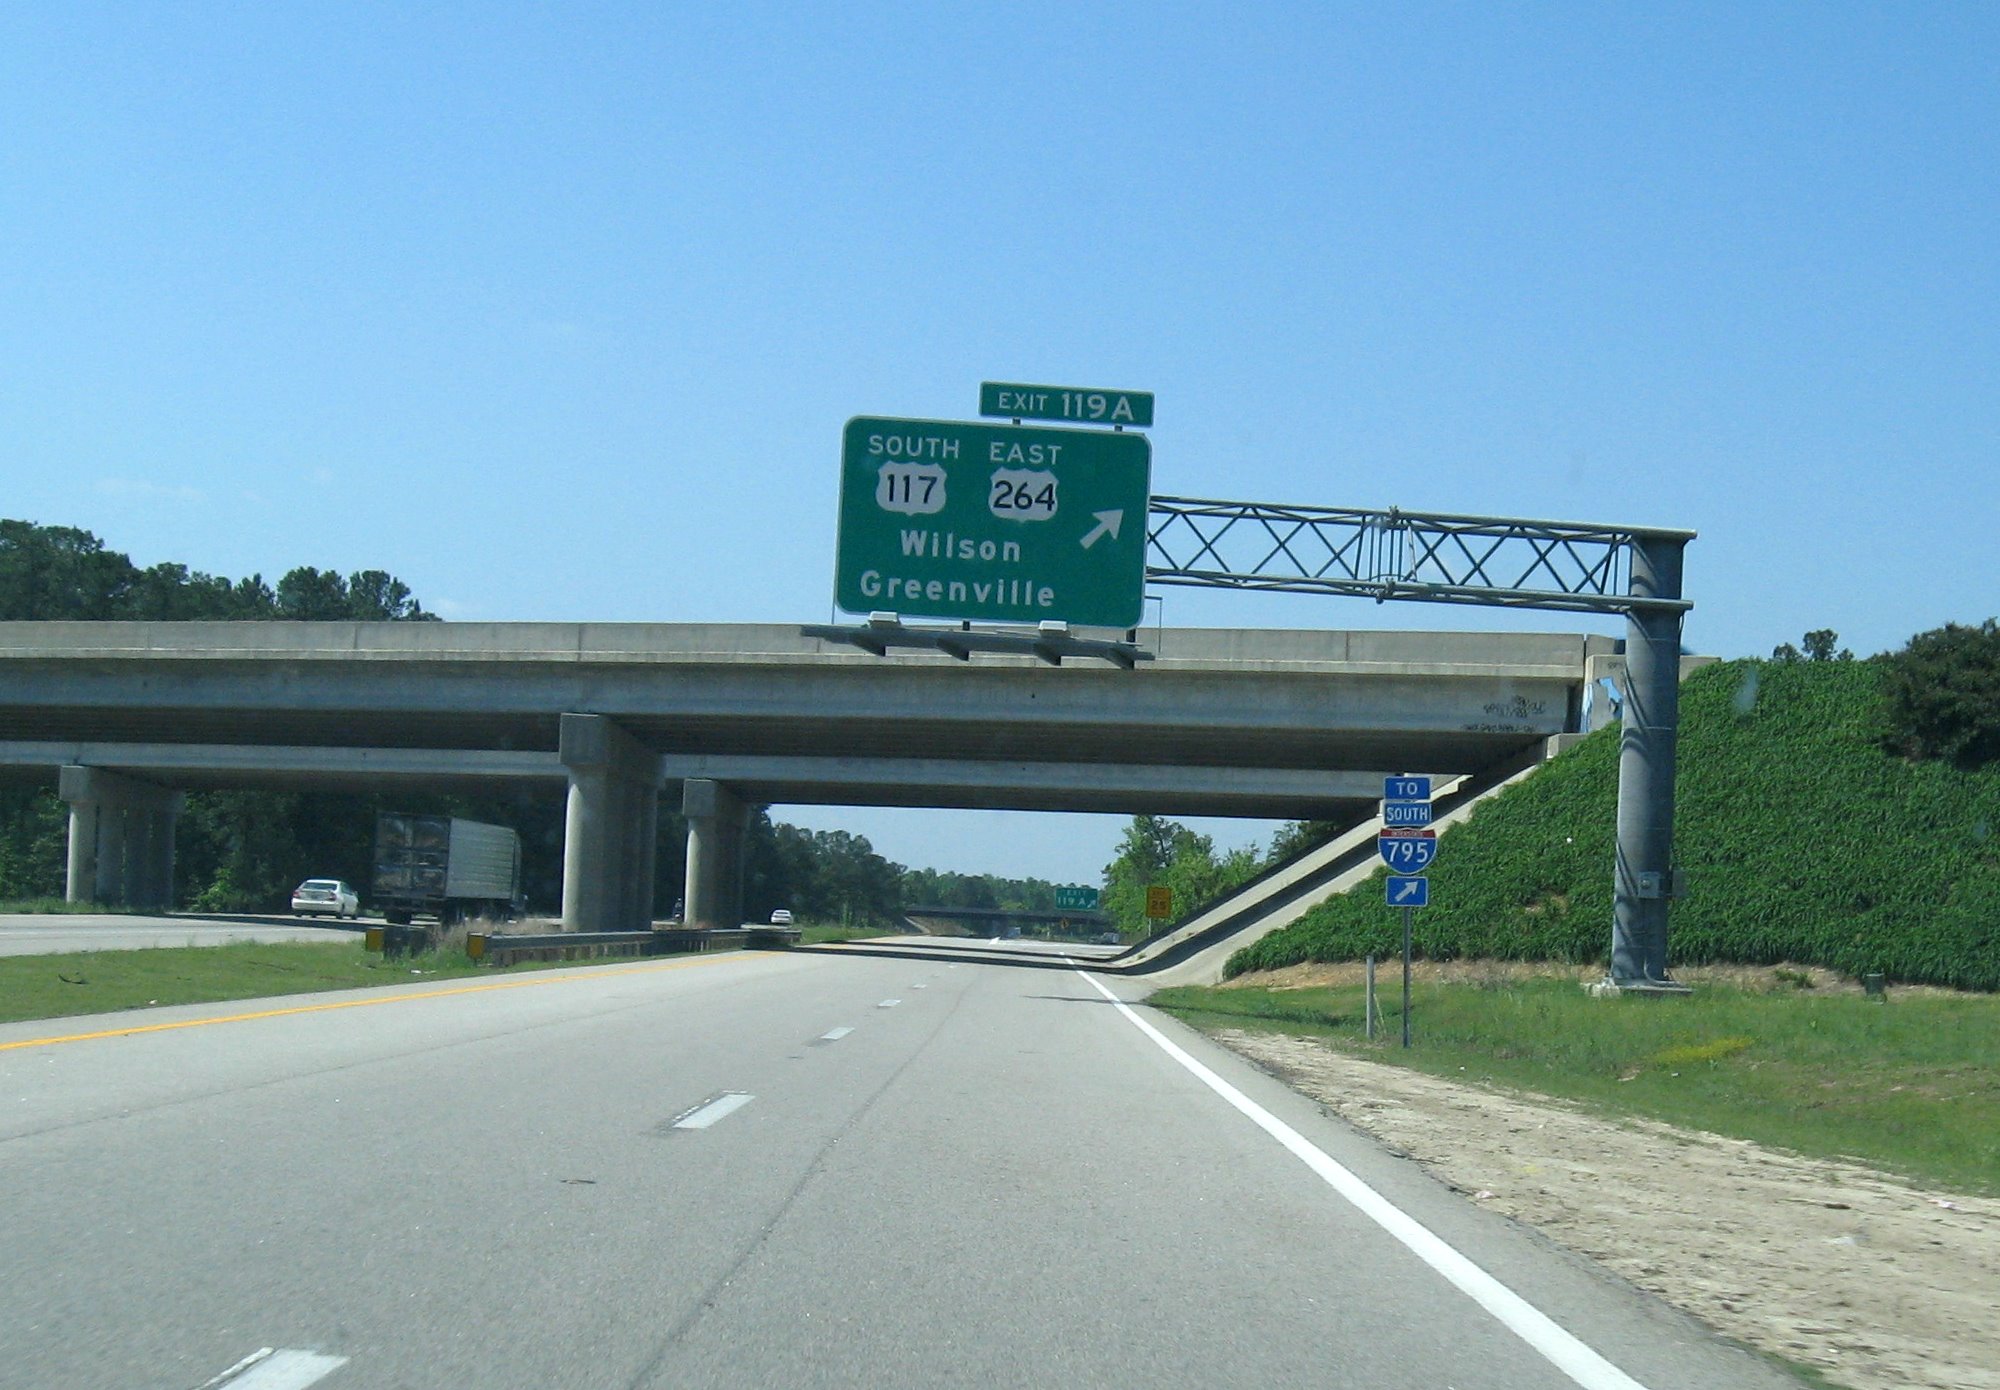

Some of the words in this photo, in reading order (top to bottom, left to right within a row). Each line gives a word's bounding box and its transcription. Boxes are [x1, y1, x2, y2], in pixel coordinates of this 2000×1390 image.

[998, 392, 1048, 411] EXIT
[868, 435, 960, 459] SOUTH
[989, 442, 1062, 465] EAST
[887, 474, 938, 504] 117
[993, 480, 1055, 511] 264
[900, 530, 1021, 562] Wilson
[860, 569, 1055, 607] Greenville
[1396, 782, 1418, 795] TO
[1386, 807, 1428, 821] SOUTH
[1388, 842, 1428, 862] 795
